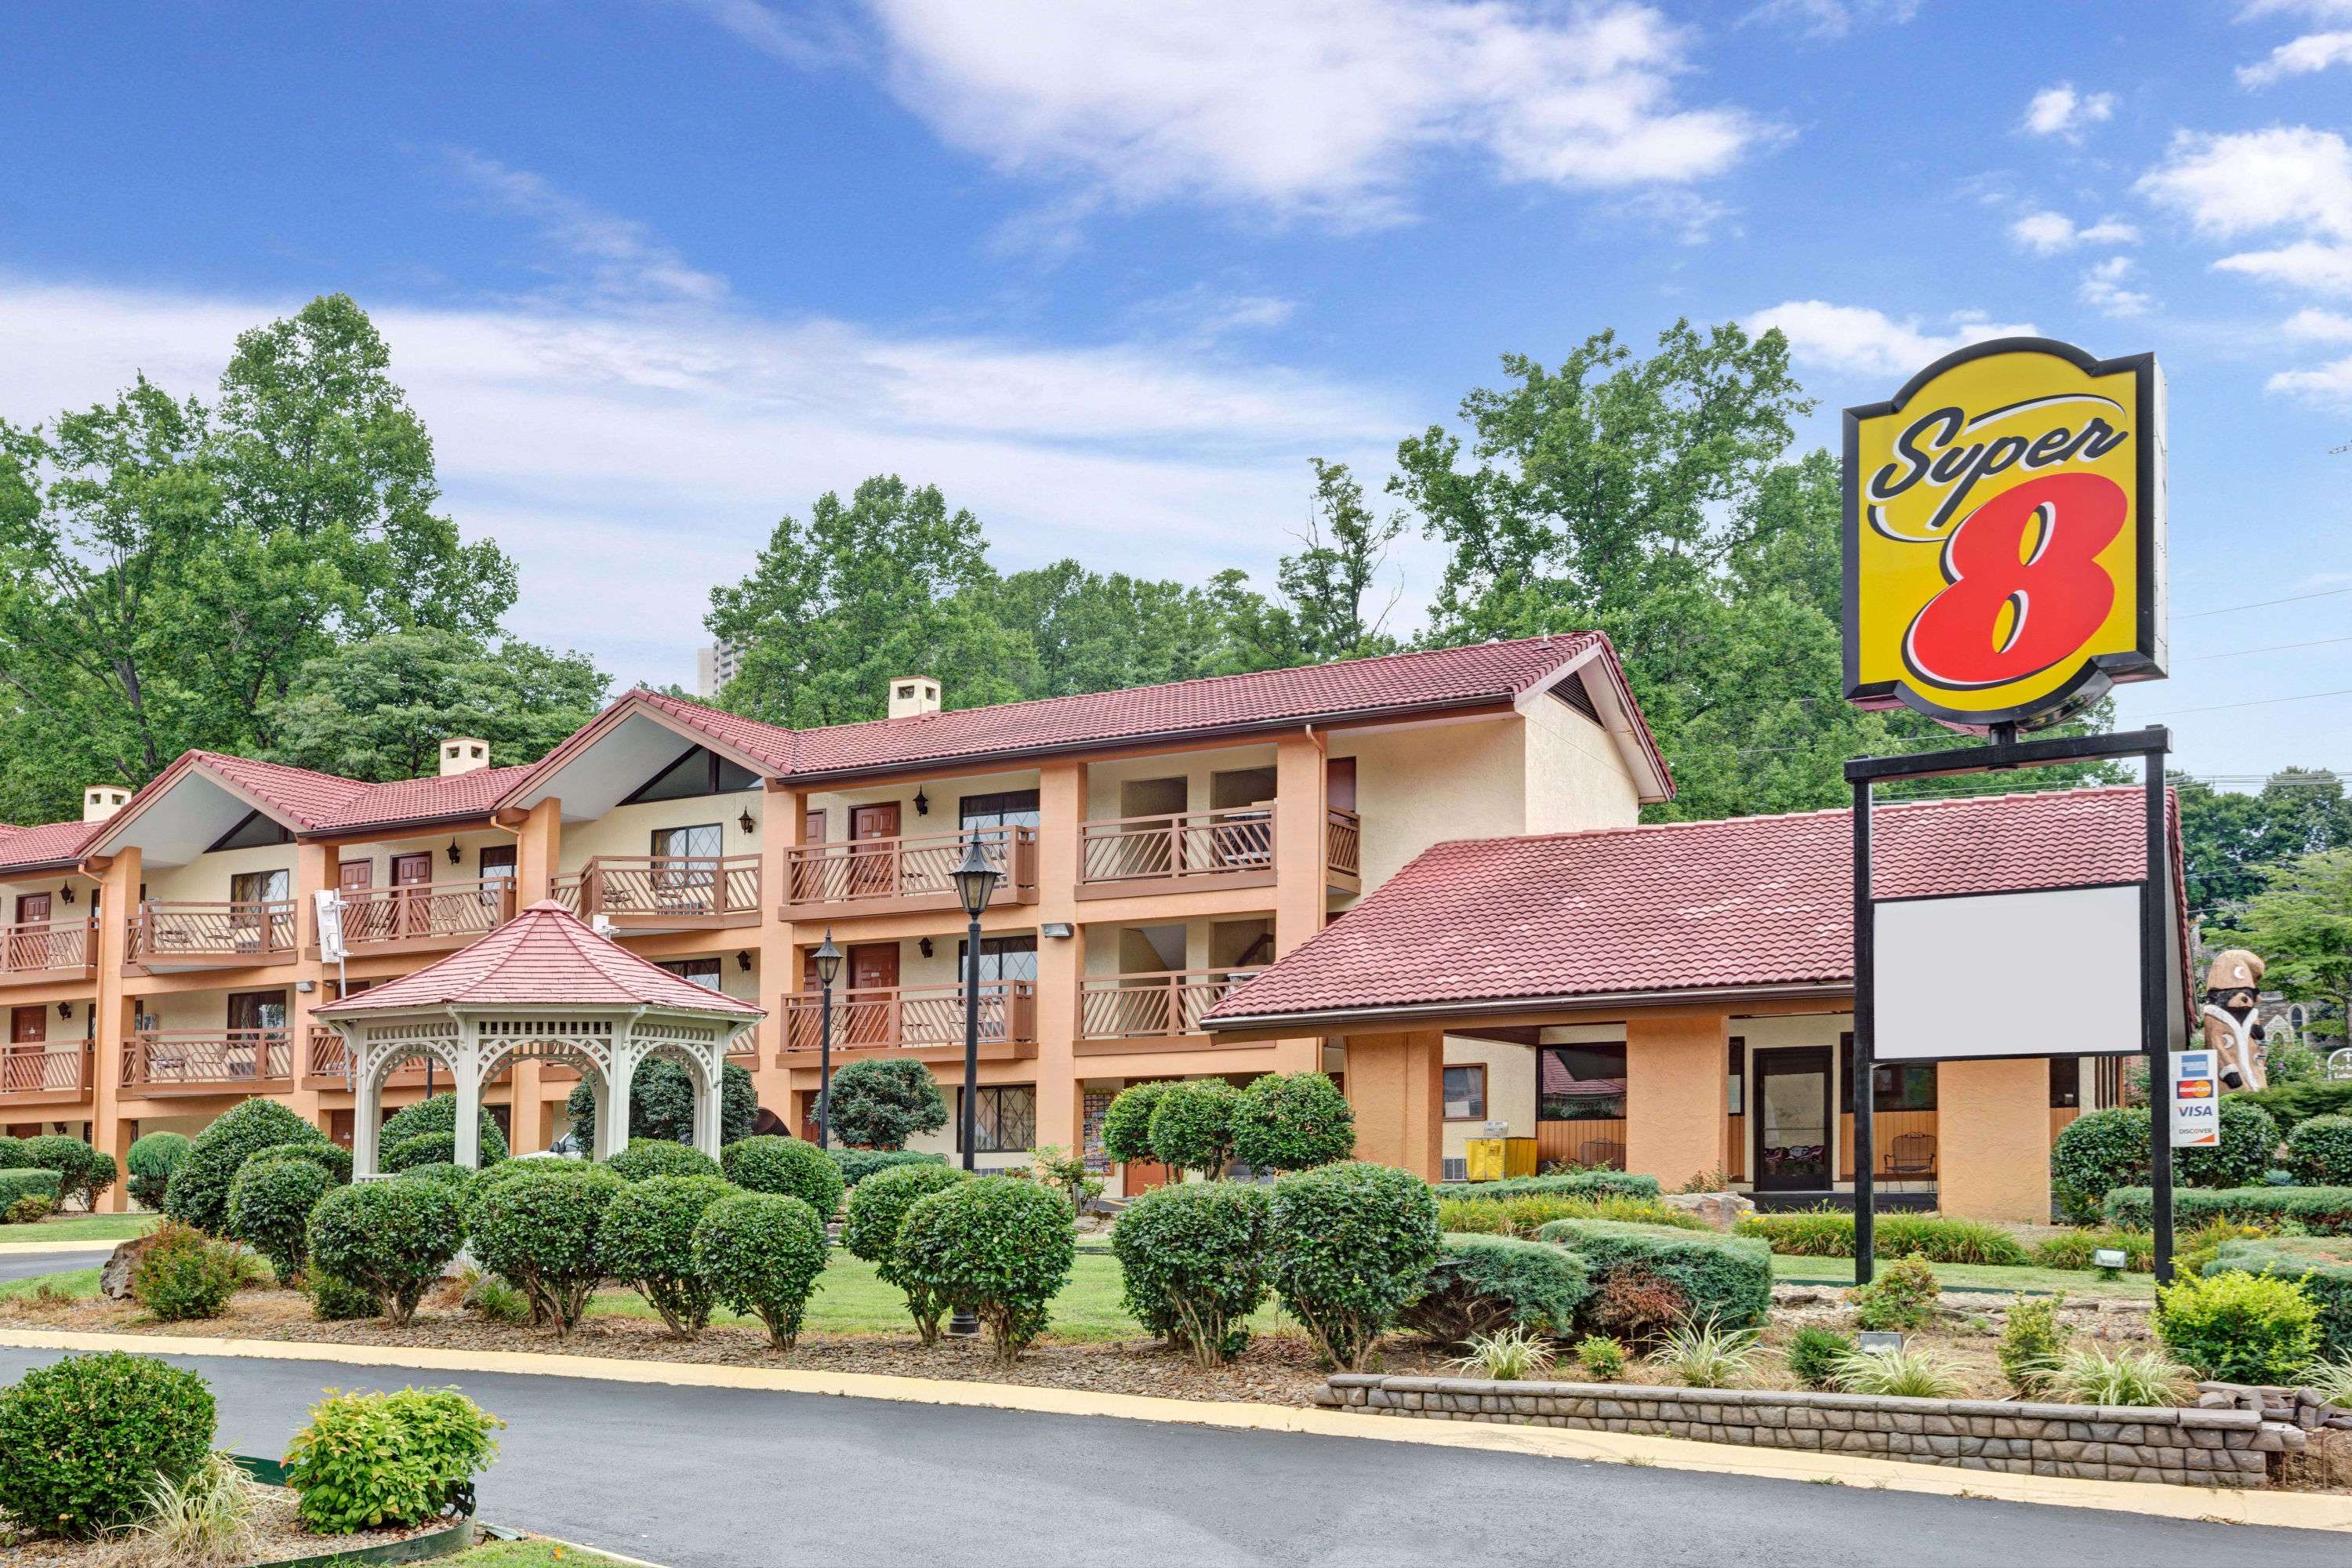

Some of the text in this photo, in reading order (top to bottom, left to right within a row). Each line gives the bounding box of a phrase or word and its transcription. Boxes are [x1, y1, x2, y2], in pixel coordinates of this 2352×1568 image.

[1866, 405, 2130, 532] Super
[1901, 472, 2129, 691] 8
[2177, 1105, 2212, 1117] VISA
